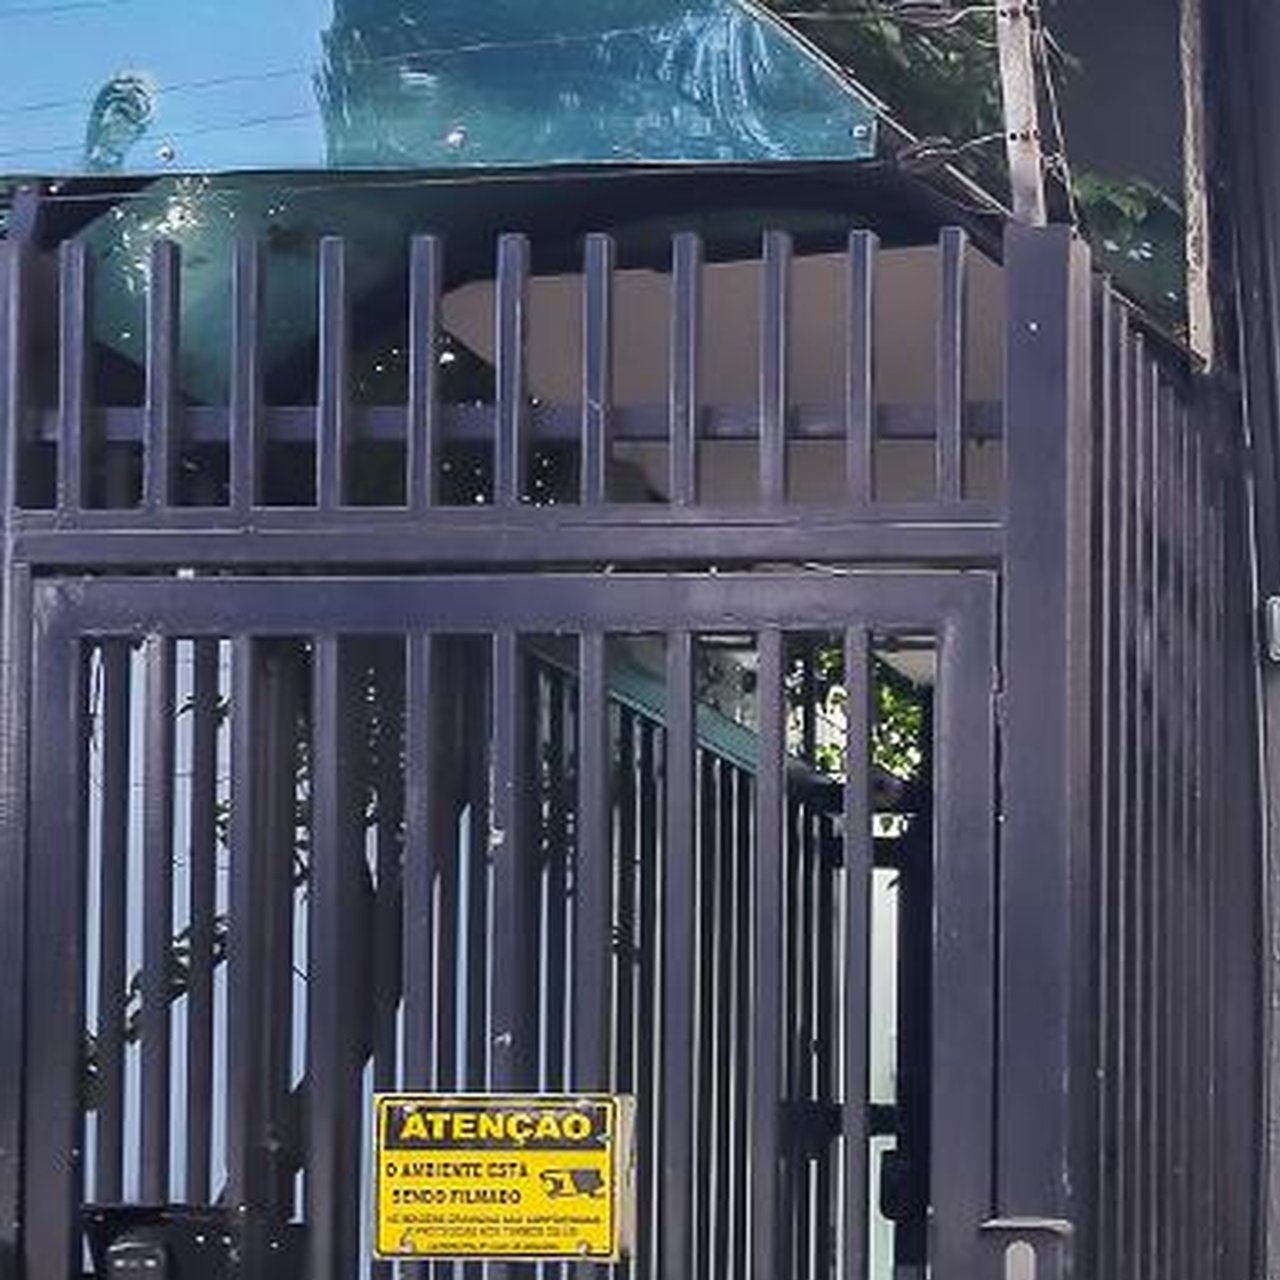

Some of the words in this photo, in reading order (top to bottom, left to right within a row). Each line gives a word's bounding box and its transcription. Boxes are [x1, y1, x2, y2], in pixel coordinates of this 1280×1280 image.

[386, 1162, 397, 1178] O
[403, 1162, 482, 1178] AMBIENTE
[392, 1189, 445, 1204] SENDO
[450, 1189, 521, 1204] FILMADO
